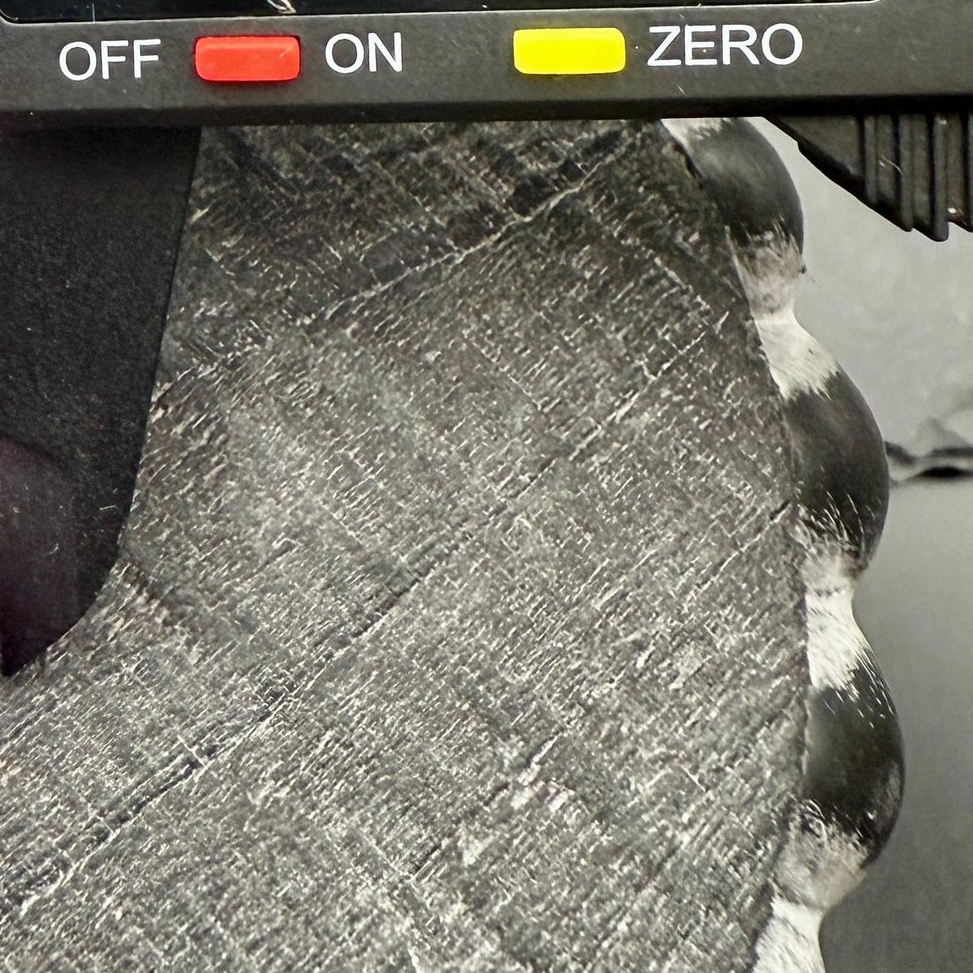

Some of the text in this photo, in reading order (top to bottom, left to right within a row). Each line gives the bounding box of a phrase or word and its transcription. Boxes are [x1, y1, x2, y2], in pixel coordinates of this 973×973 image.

[59, 23, 804, 80] OFF ON ZERO
